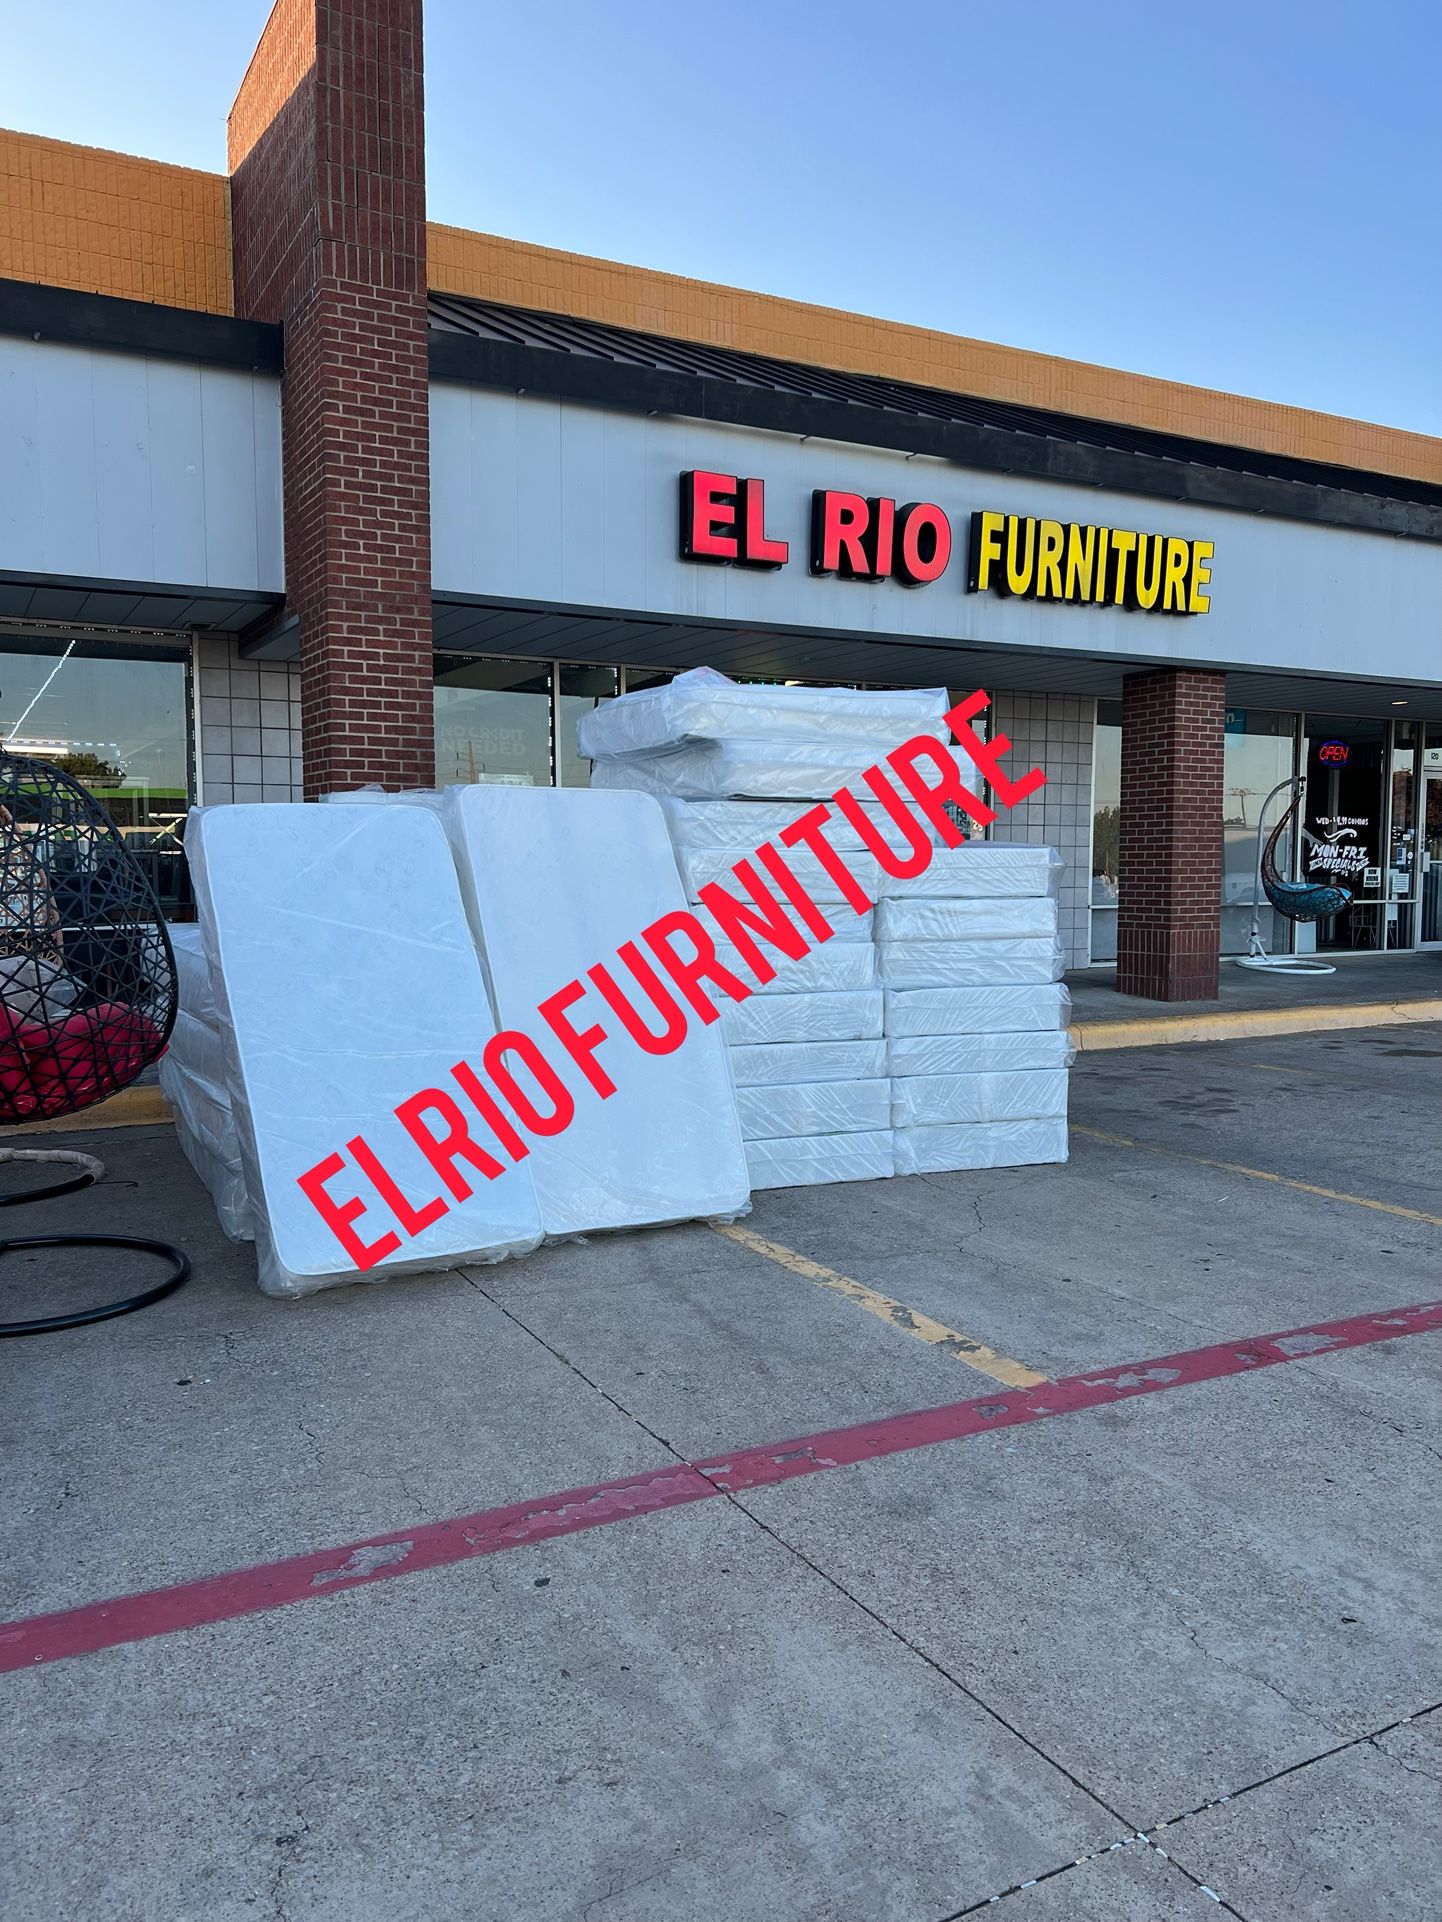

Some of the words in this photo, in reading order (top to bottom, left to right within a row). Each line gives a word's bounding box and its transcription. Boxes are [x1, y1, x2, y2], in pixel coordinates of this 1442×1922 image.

[683, 468, 788, 565] EL
[814, 490, 951, 582] RIO
[972, 510, 1215, 614] FURNITURE
[440, 723, 465, 737] NO
[440, 738, 527, 756] NEEDED
[1319, 746, 1349, 762] OPEN
[1309, 843, 1368, 859] MON-FRI
[1322, 858, 1357, 872] SPECIALS
